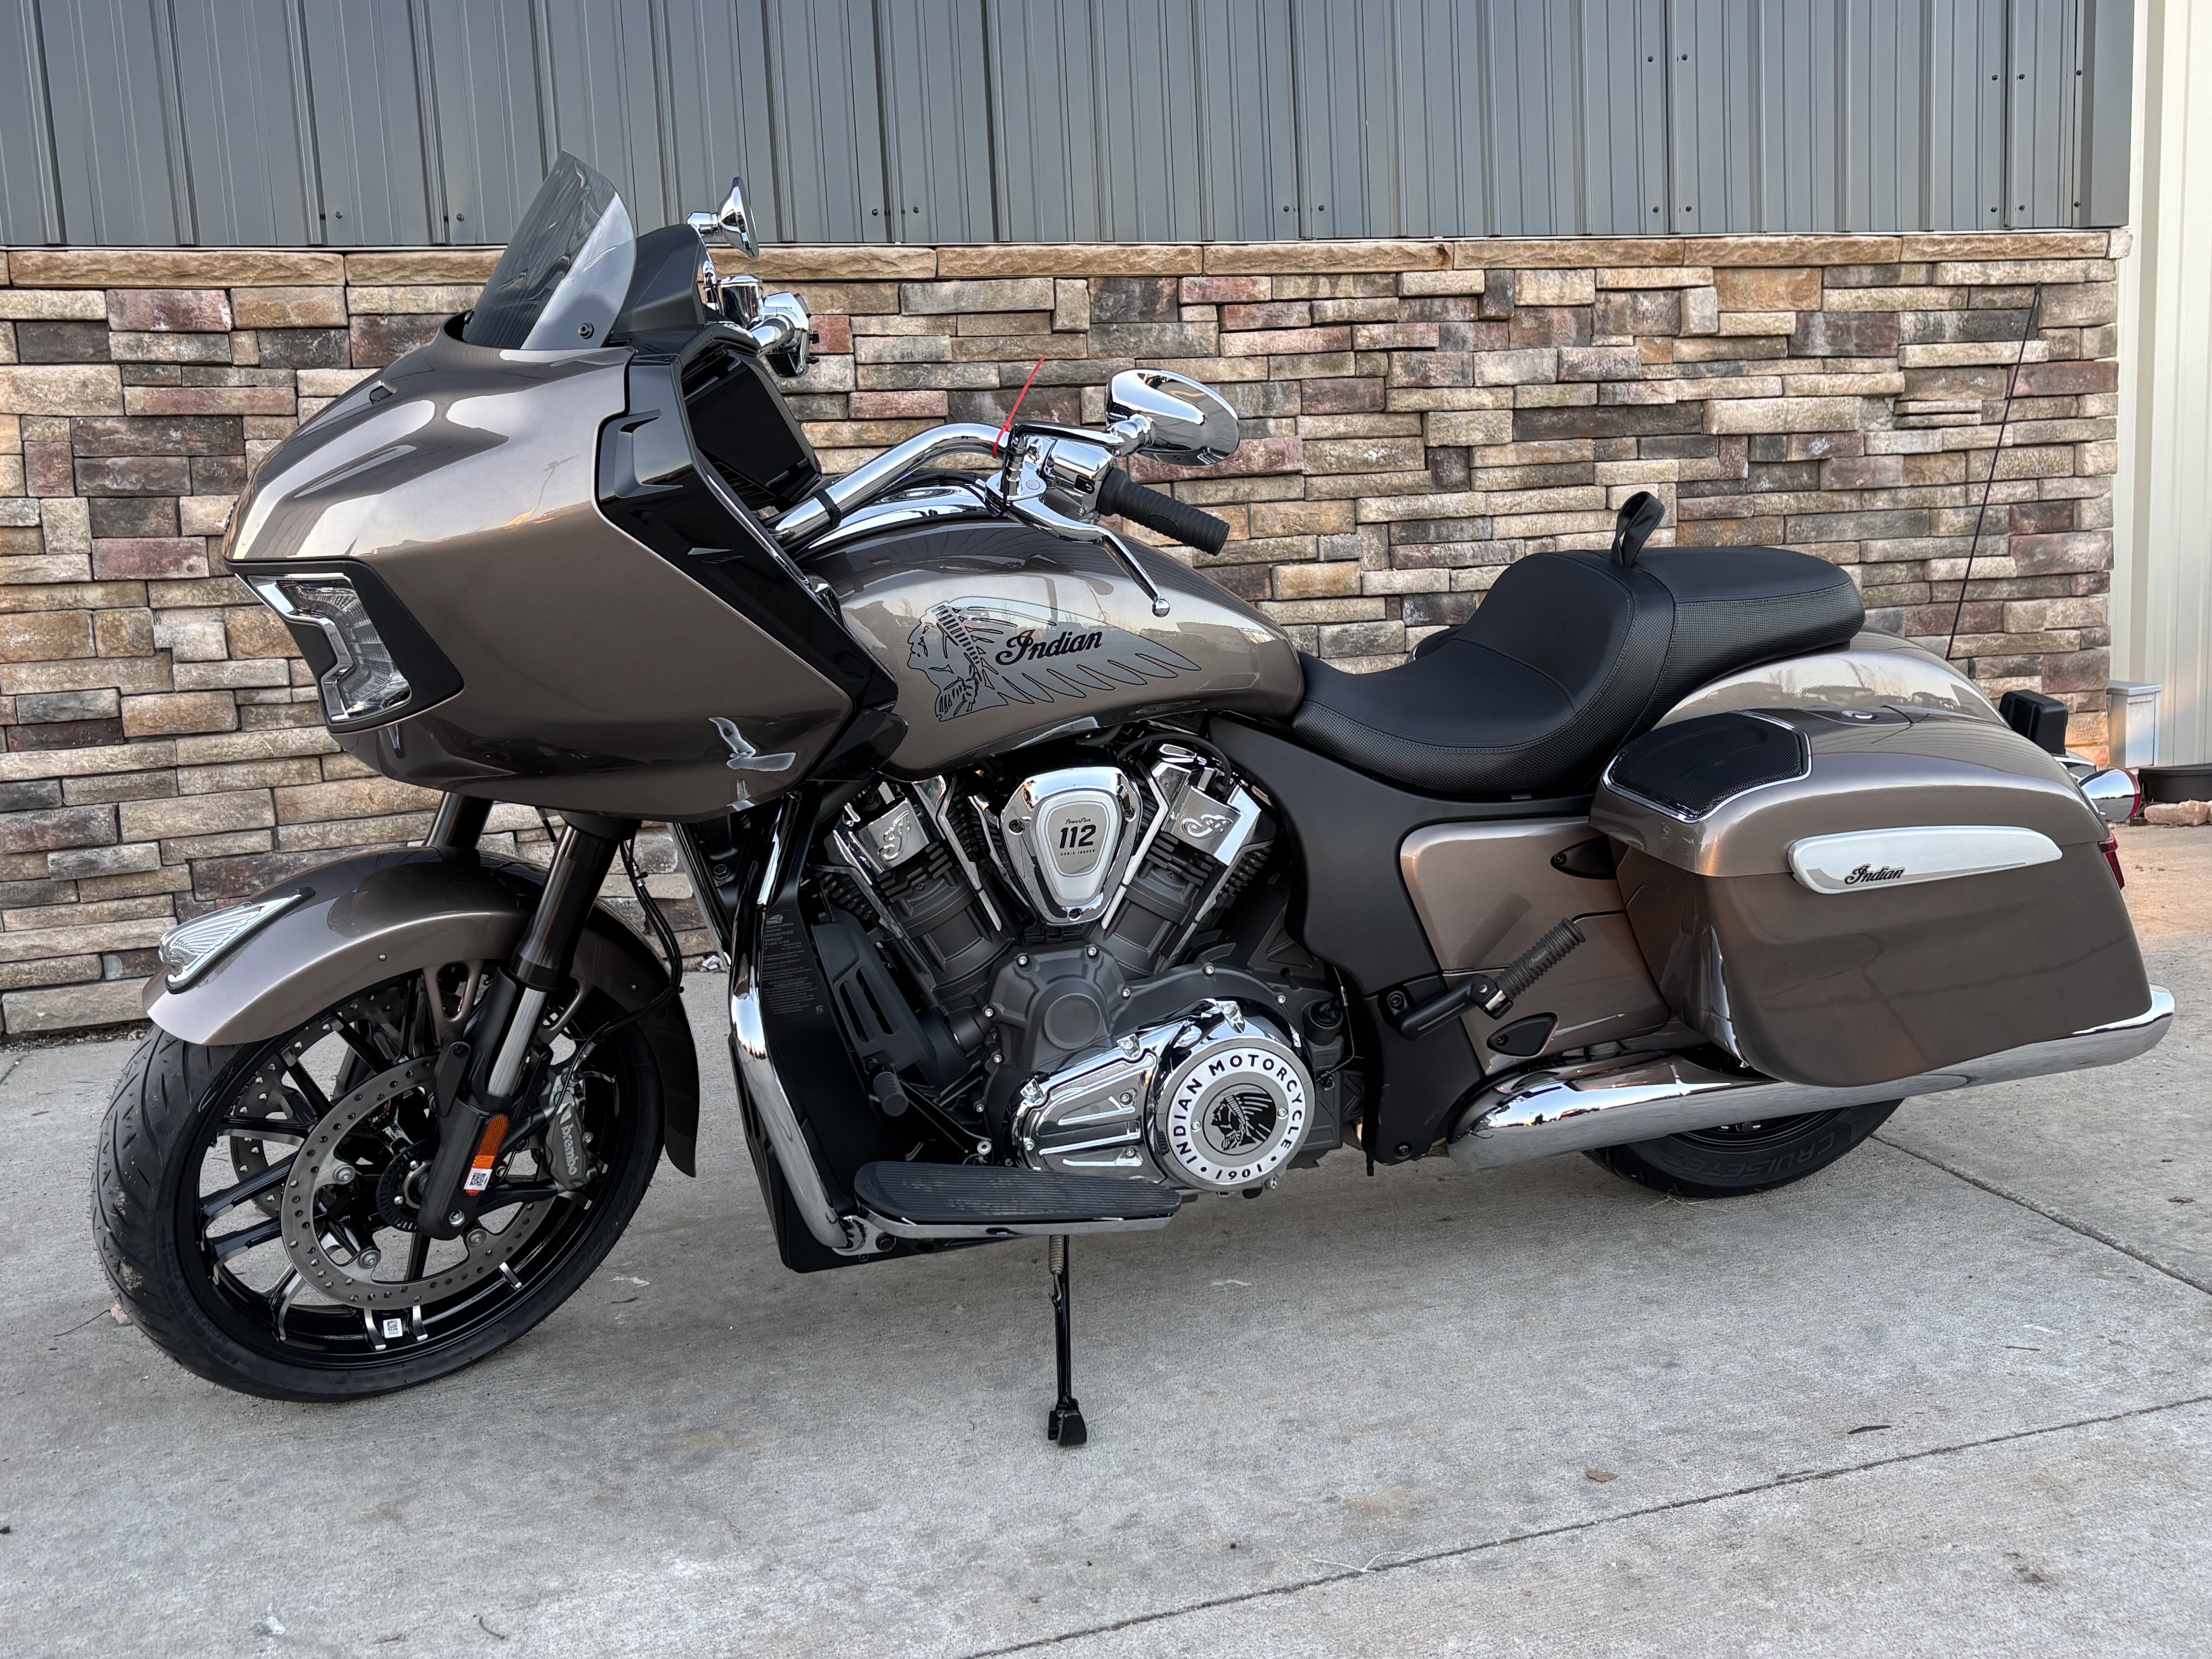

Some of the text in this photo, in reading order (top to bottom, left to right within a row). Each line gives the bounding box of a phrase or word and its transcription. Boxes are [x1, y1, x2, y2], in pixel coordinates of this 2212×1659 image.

[995, 629, 1103, 665] Indian
[1060, 824, 1096, 848] 112
[1844, 864, 1905, 884] Indian
[1173, 1054, 1302, 1165] INDIAN MOTORCYCLE
[561, 1123, 579, 1175] brembo
[1215, 1163, 1262, 1180] 1901
